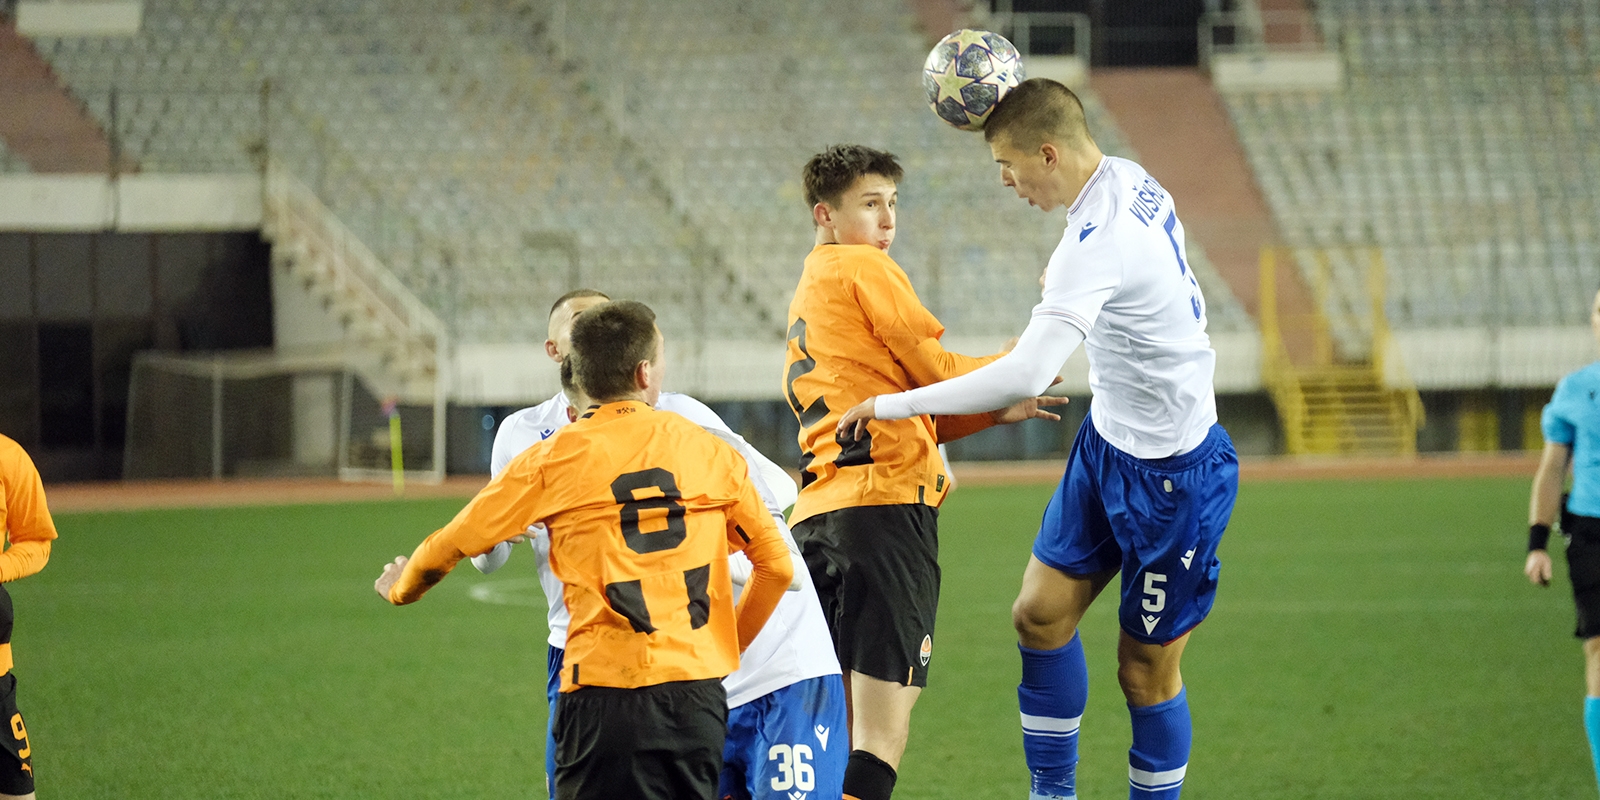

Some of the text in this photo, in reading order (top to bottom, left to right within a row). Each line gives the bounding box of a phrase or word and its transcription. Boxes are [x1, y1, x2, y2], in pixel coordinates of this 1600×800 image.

[1162, 206, 1202, 322] 5
[786, 316, 831, 429] 2
[610, 467, 687, 554] 8
[1141, 571, 1167, 612] 5
[10, 712, 31, 759] 9
[768, 743, 815, 791] 36
